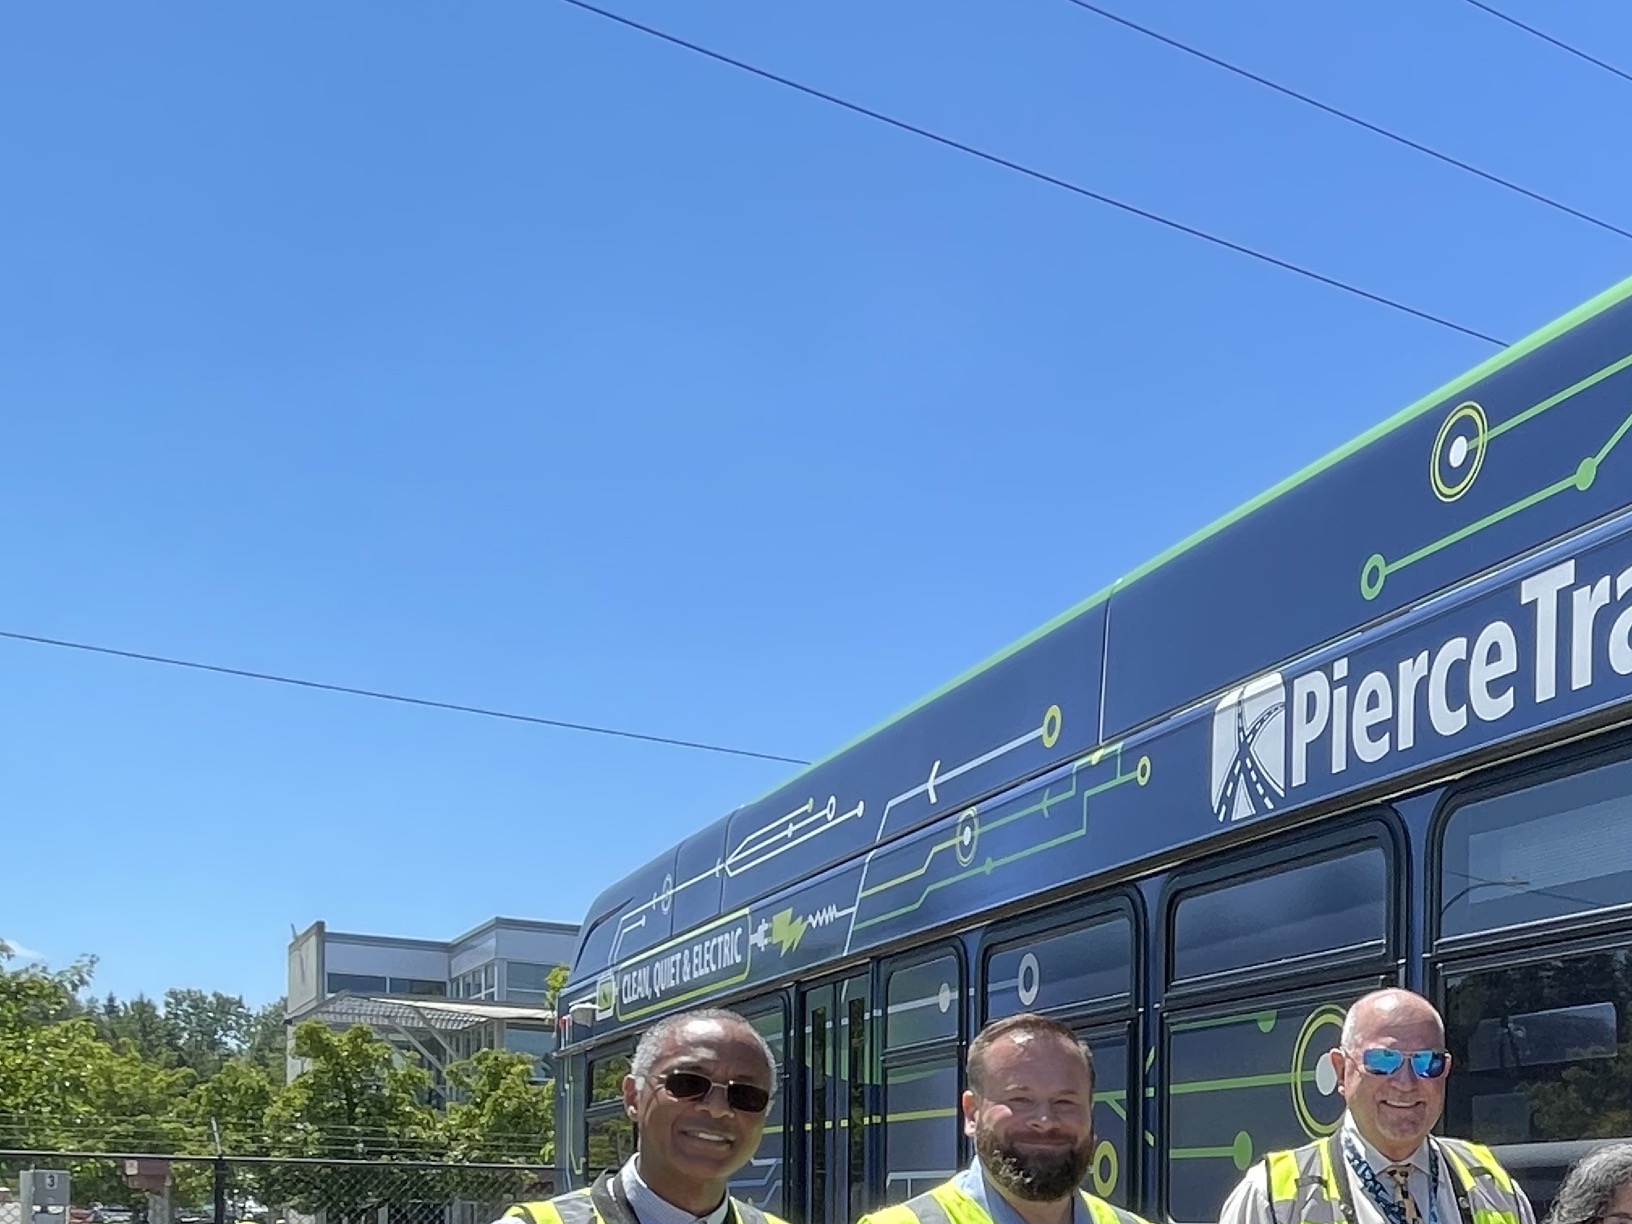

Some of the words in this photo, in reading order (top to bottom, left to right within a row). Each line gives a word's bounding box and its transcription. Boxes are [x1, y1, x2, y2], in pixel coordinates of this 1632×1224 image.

[621, 964, 652, 1005] CLEAN,
[652, 951, 682, 998] QUIET
[682, 948, 692, 983] &
[692, 926, 743, 979] ELECTRIC
[47, 1173, 55, 1188] 3
